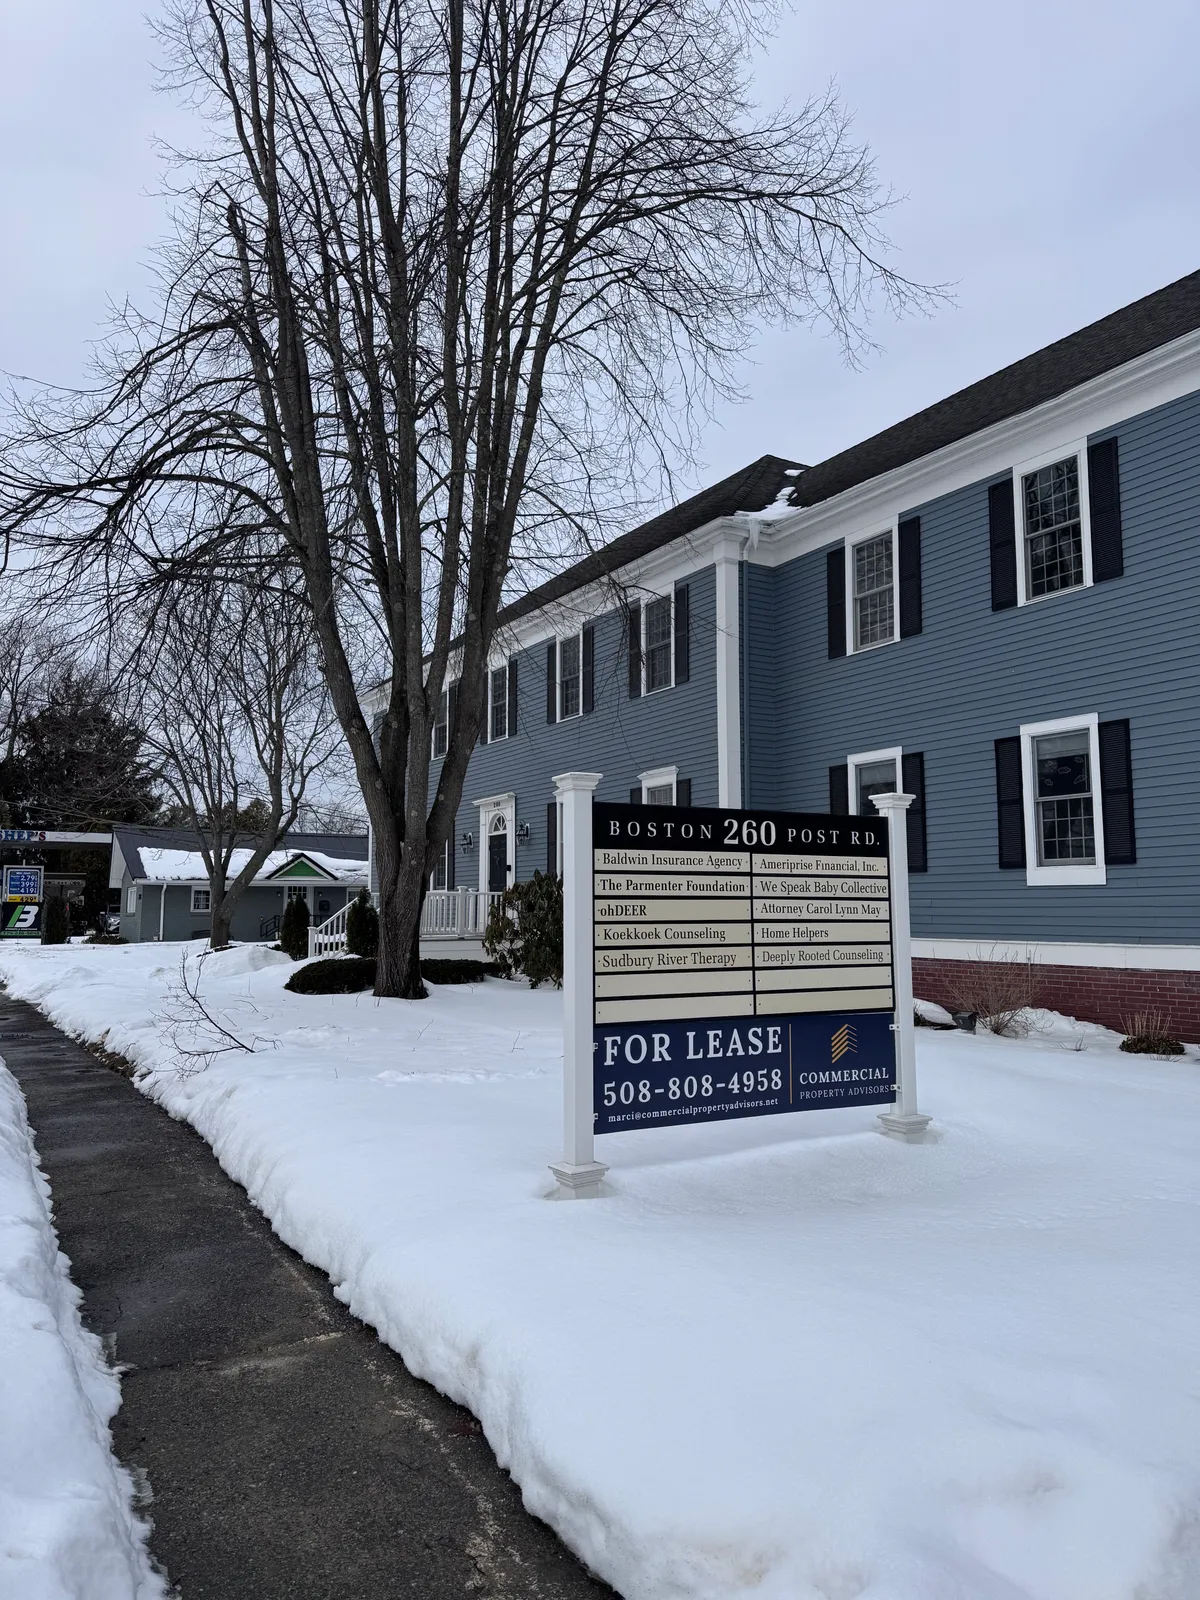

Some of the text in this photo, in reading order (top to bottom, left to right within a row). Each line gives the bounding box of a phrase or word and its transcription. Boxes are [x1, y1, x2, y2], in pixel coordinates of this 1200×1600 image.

[609, 818, 880, 846] BOSTON 260 POST RD.
[603, 853, 743, 870] Baldwin Insurance Agency
[760, 859, 879, 872] Ameriprise Financial, Inc.
[600, 879, 745, 892] The Parmenter Foundation
[760, 881, 887, 896] We Speak Baby Collective
[600, 904, 647, 917] ohDEER
[761, 903, 881, 917] Attorney Carol Lynn May
[603, 927, 726, 942] Koekkoek Counseling
[761, 927, 829, 940] Home Helpers
[603, 951, 737, 970] Sudbury River Therapy
[762, 949, 884, 964] Deeply Rooted Counseling
[604, 1026, 782, 1066] FOR LEASE
[799, 1067, 889, 1085] COMMERCIAL
[603, 1068, 782, 1106] 508-808-4958
[800, 1084, 889, 1100] PROPERTY ADVISORS
[608, 1098, 778, 1122] marci@commercialpropertyadvisors.net
